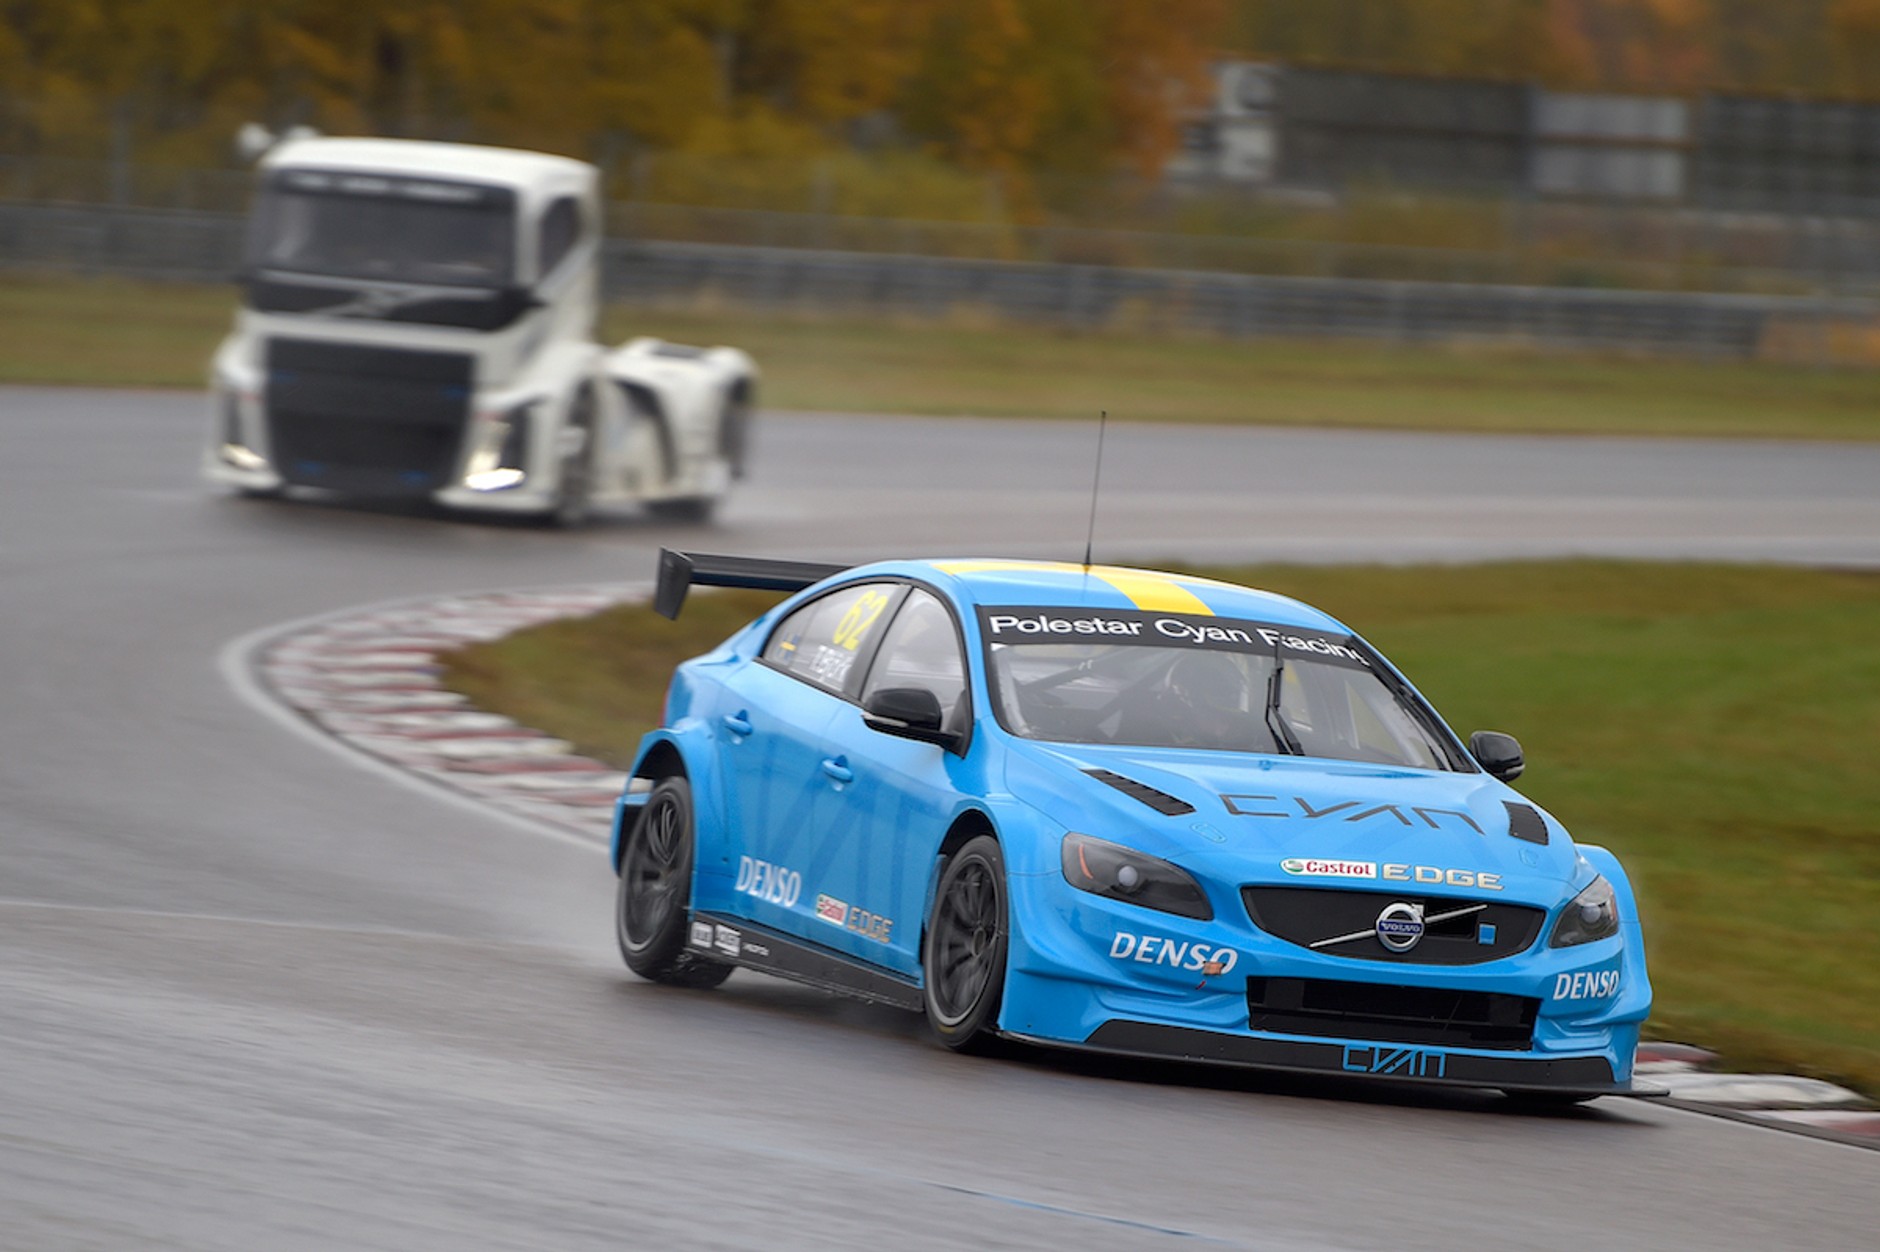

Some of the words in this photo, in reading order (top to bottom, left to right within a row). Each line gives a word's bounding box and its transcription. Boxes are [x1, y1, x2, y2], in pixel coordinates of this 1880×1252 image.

[833, 590, 889, 651] 62
[989, 615, 1143, 636] Polestar
[1153, 618, 1253, 643] Cyan
[734, 855, 801, 907] DENSO
[1306, 860, 1372, 876] Castrol
[1382, 863, 1505, 891] EDGE
[847, 906, 893, 944] EDGE
[1380, 922, 1421, 933] VOLVO
[1109, 931, 1239, 975] DENSO
[1552, 969, 1621, 1000] DENSO
